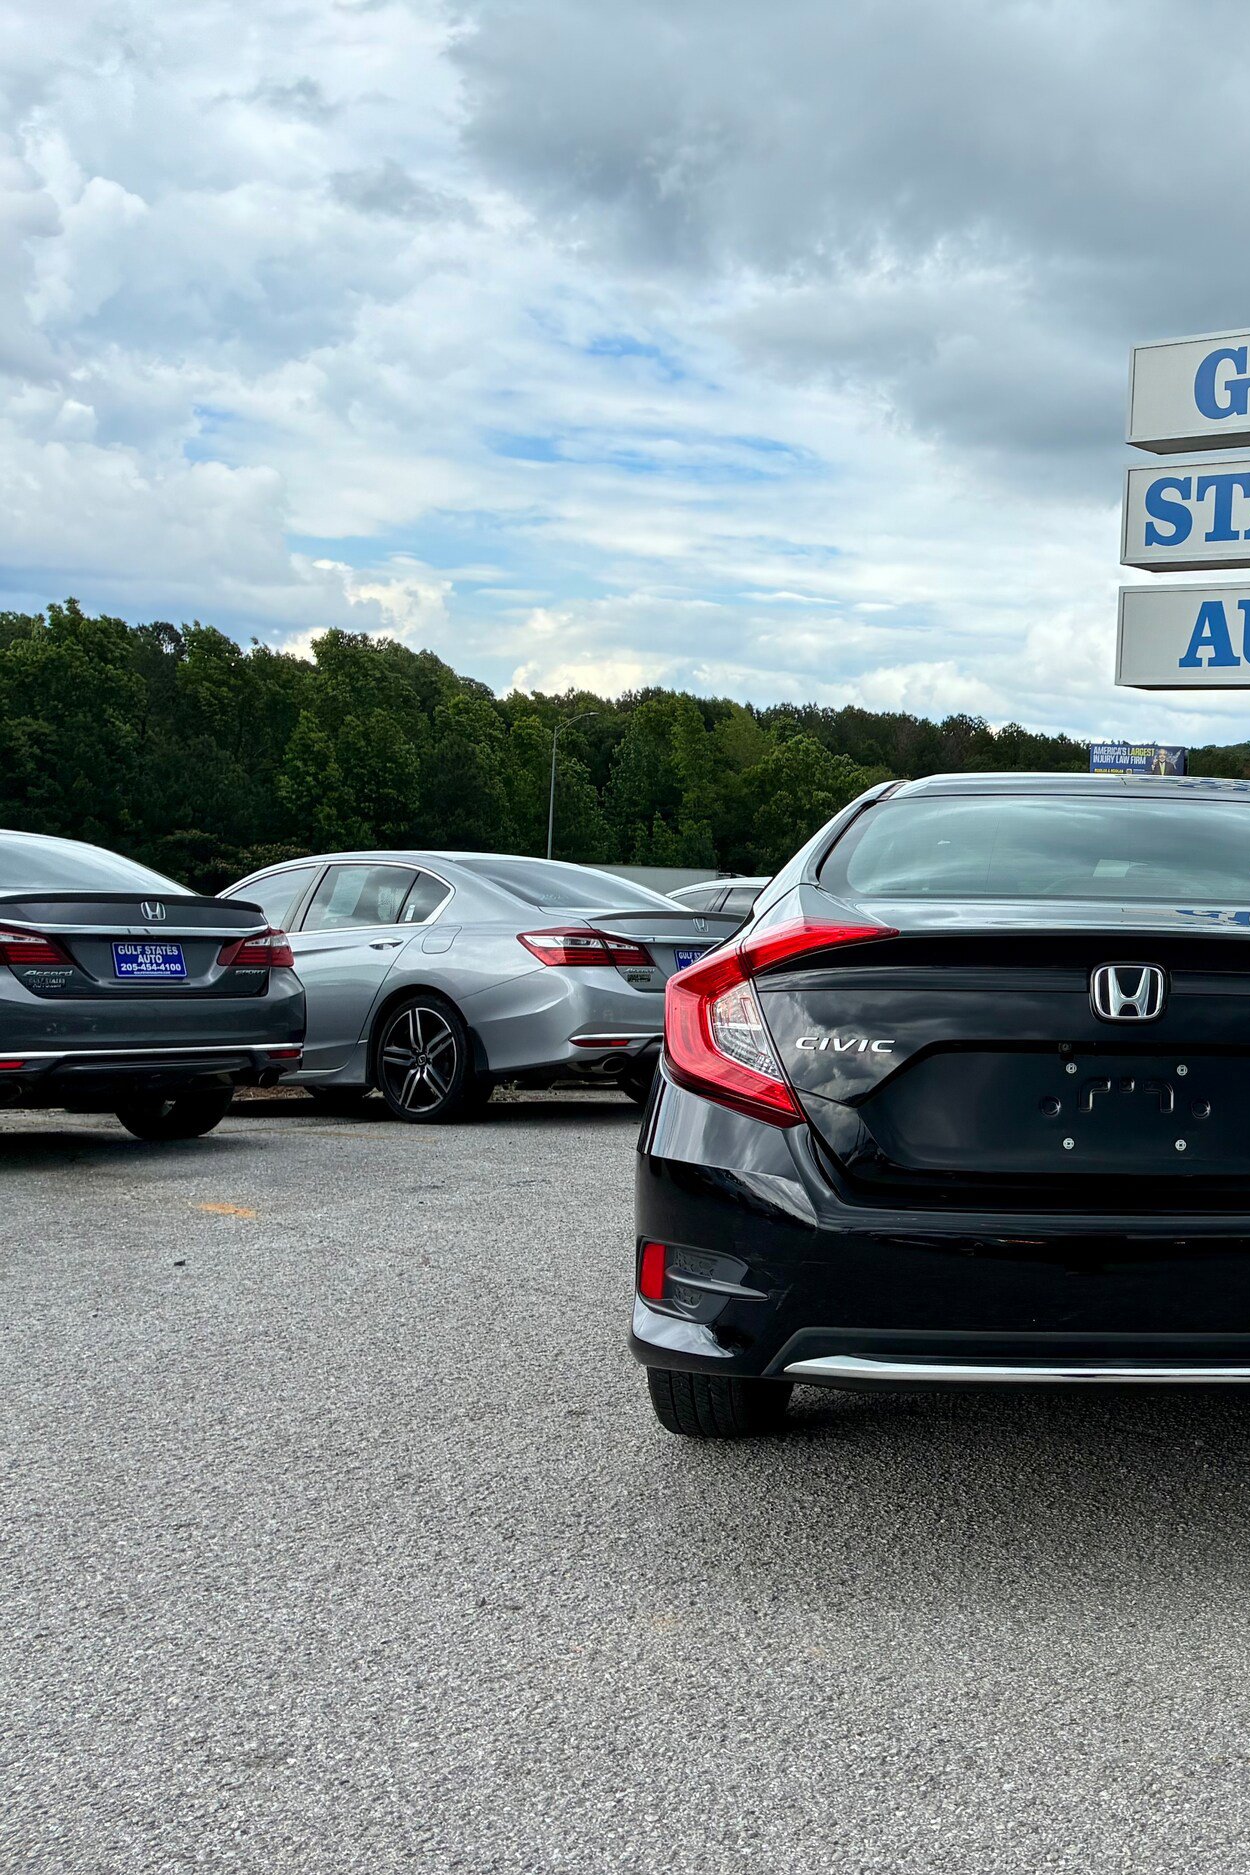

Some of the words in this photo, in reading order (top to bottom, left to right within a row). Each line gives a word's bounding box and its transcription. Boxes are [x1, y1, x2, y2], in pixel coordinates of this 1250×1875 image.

[1093, 746, 1127, 755] AMERICA'S
[1127, 748, 1155, 756] LARGEST
[1093, 755, 1115, 763] INJURY
[1130, 756, 1146, 764] FIRM
[117, 945, 143, 955] GULF
[144, 946, 179, 955] STATES
[137, 954, 163, 964] AUTO
[678, 952, 693, 960] GULF
[120, 963, 182, 971] 205-454-4100
[795, 1036, 896, 1053] CIVIC
